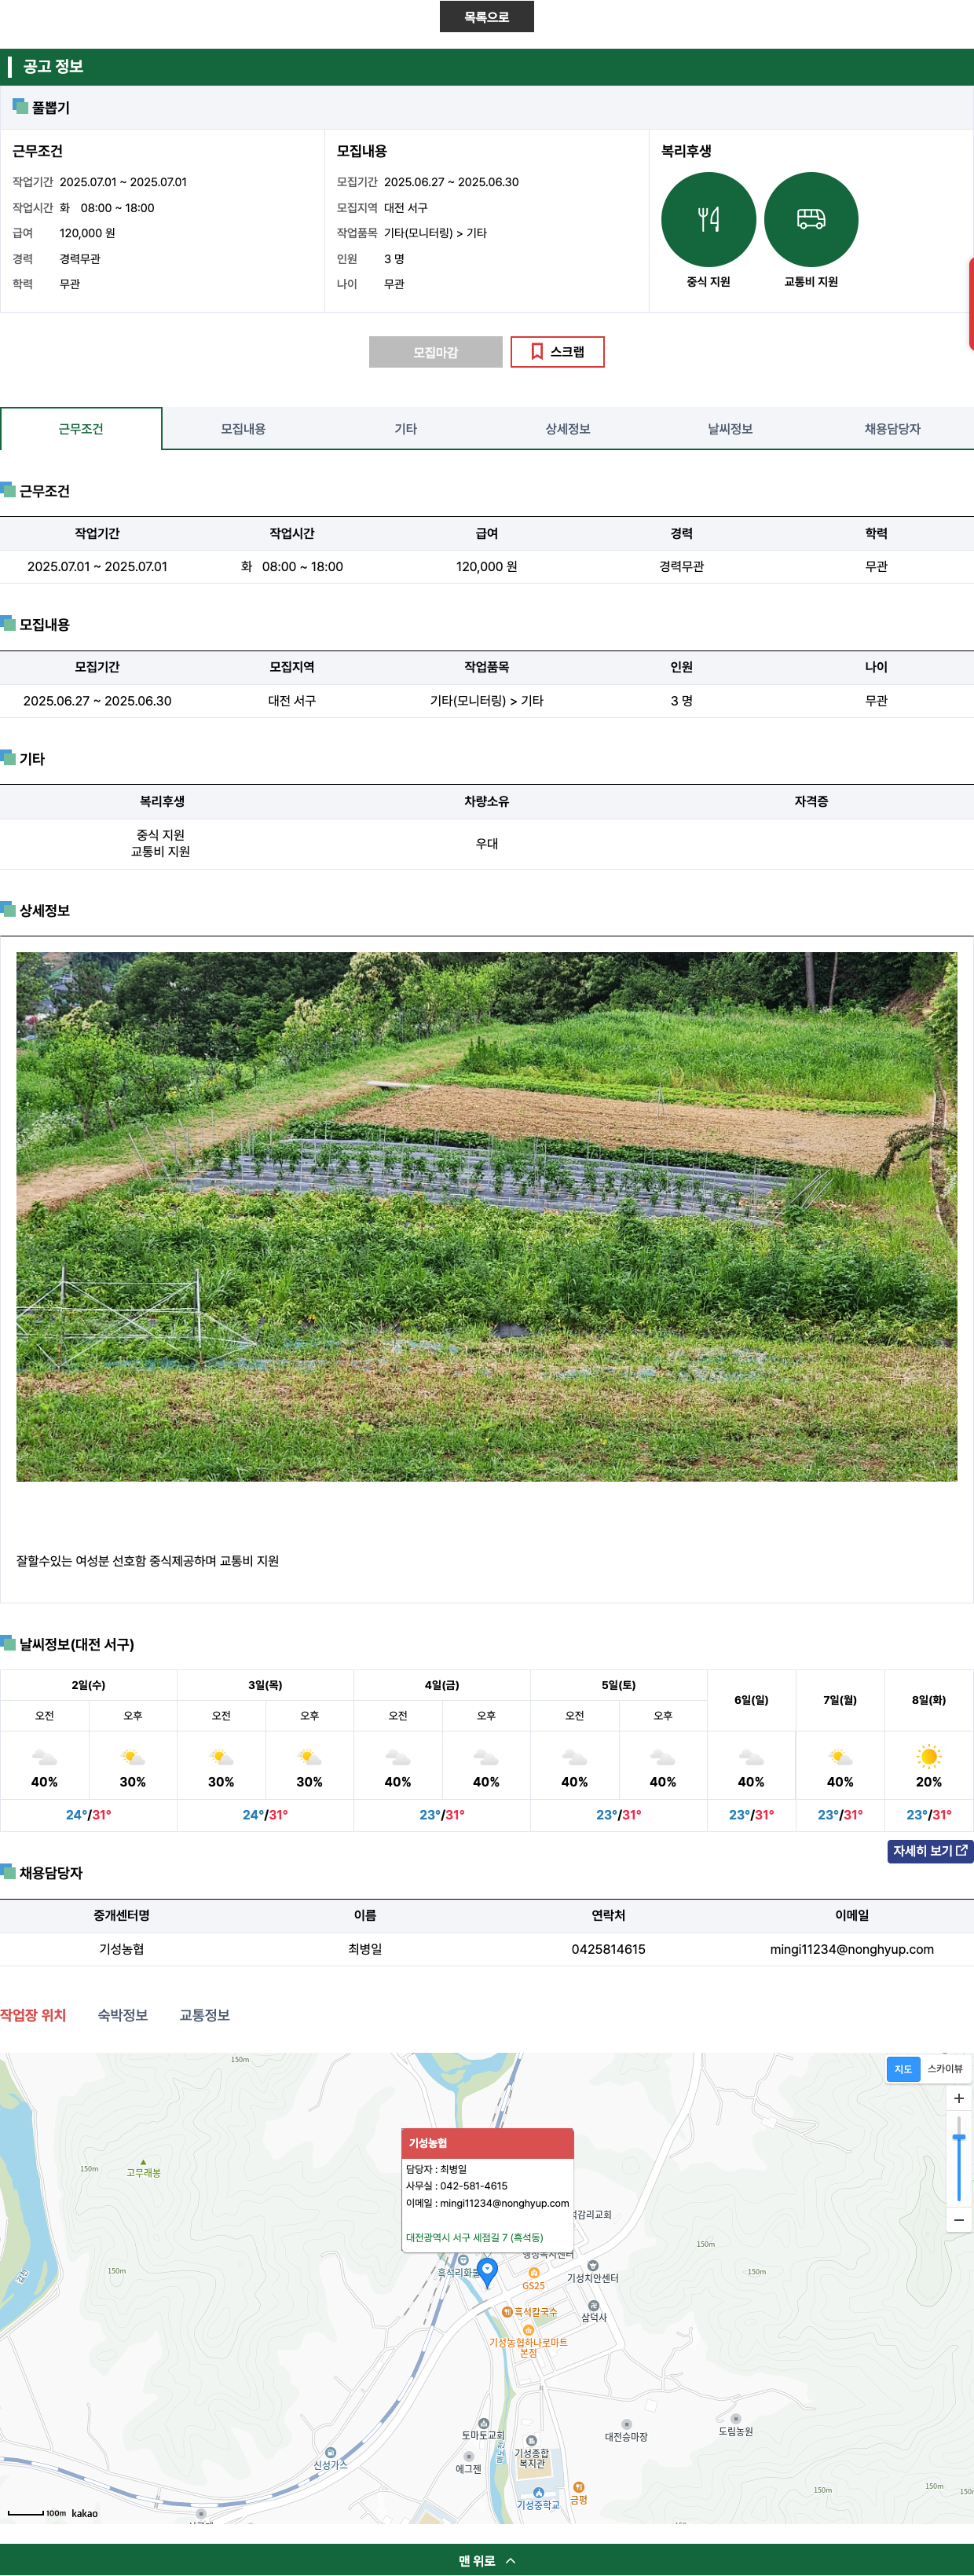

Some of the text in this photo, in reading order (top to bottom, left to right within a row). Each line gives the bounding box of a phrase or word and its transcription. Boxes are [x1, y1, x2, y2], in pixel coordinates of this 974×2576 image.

[465, 12, 509, 24] 목록으로
[24, 59, 83, 74] 공고 정보
[32, 101, 69, 115] 풀뽑기
[13, 145, 62, 158] 근무조건
[337, 145, 387, 158] 모집내용
[661, 145, 711, 158] 복리후생
[13, 177, 53, 187] 작업기간
[60, 178, 115, 186] 2025.07.01
[130, 178, 186, 186] 2025.07.01
[385, 178, 445, 186] 2025.06.27
[459, 178, 518, 186] 2025.06.30
[13, 203, 53, 213] 작업시간
[60, 203, 70, 213] 화
[81, 203, 112, 212] 08:00
[126, 203, 154, 212] 18:00
[385, 203, 427, 213] 대전 서구
[13, 228, 32, 238] 급여
[60, 228, 115, 240] 120,000 원
[385, 228, 452, 239] 기타(모니터링)
[467, 228, 487, 238] 기타
[13, 254, 32, 264] 경력
[60, 254, 101, 264] 경력무관
[385, 254, 404, 264] 3 명
[13, 279, 32, 289] 학력
[60, 279, 80, 289] 무관
[384, 279, 405, 289] 무관
[687, 277, 730, 288] 중식 지원
[785, 277, 837, 288] 교통비 지원
[414, 346, 459, 359] 모집마감
[551, 346, 584, 357] 스크랩
[59, 423, 103, 435] 근무조건
[222, 423, 265, 435] 모집내용
[395, 423, 417, 435] 기타
[546, 423, 590, 435] 상세정보
[709, 423, 752, 435] 날씨정보
[865, 423, 921, 435] 채용담당자
[20, 485, 69, 498] 근무조건
[20, 618, 70, 632] 모집내용
[75, 661, 120, 673] 모집기간
[270, 661, 313, 673] 모집지역
[465, 661, 509, 673] 작업품목
[671, 661, 692, 672] 인원
[866, 661, 887, 673] 나이
[20, 753, 45, 766] 기타
[140, 795, 184, 808] 복리후생
[465, 795, 509, 808] 차량소유
[795, 795, 829, 808] 자격증
[476, 838, 497, 850] 우대
[20, 904, 70, 918] 상세정보
[16, 1555, 278, 1567] 잘할수있는 여성분 선호함 중식제공하며 교통비 지원
[20, 1638, 134, 1652] 날씨정보(대전 서구)
[72, 1680, 105, 1691] 2일(수)
[248, 1680, 282, 1691] 3일(목)
[425, 1680, 459, 1691] 4일(금)
[602, 1680, 635, 1691] 5일(토)
[734, 1695, 768, 1706] 6일(일)
[824, 1695, 856, 1706] 7일(월)
[912, 1695, 946, 1706] 8일(화)
[35, 1711, 53, 1720] 오전
[124, 1711, 142, 1720] 오후
[212, 1711, 230, 1720] 오전
[301, 1711, 319, 1720] 오후
[31, 1776, 57, 1787] 40%
[120, 1776, 145, 1787] 30%
[208, 1776, 234, 1787] 30%
[297, 1776, 322, 1787] 30%
[385, 1776, 411, 1787] 40%
[473, 1777, 500, 1787] 40%
[562, 1776, 588, 1787] 40%
[917, 1776, 942, 1787] 20%
[67, 1809, 111, 1821] 24°/31°
[420, 1809, 464, 1821] 23°/31°
[597, 1809, 641, 1821] 23°/31°
[894, 1845, 952, 1857] 자세히 보기
[20, 1867, 82, 1880] 채용담당자
[93, 1909, 149, 1922] 중개센터명
[354, 1909, 376, 1922] 이름
[592, 1909, 624, 1922] 연락처
[836, 1909, 869, 1922] 이메일
[100, 1944, 143, 1955] 기성농협
[349, 1944, 382, 1955] 최병일
[572, 1944, 645, 1954] 0425814615
[771, 1944, 933, 1957] mingi11234@nonghyup.com
[0, 2009, 65, 2022] 작업장 위치
[98, 2009, 148, 2022] 숙박정보
[180, 2009, 229, 2022] 교통정보
[895, 2065, 912, 2074] 지도
[928, 2064, 963, 2073] 스카이뷰
[409, 2138, 446, 2149] 기성농협
[126, 2168, 161, 2178] 고무래봉
[407, 2164, 433, 2174] 담당자
[441, 2164, 466, 2174] 최병일
[406, 2181, 432, 2190] 사무실
[407, 2198, 432, 2208] 이메일
[441, 2199, 569, 2209] mingi11234@nonghyup.com
[407, 2233, 449, 2242] 대전광역시
[453, 2233, 471, 2242] 서구
[474, 2233, 499, 2242] 세점길
[511, 2233, 543, 2243] (흑석동)
[568, 2274, 618, 2283] 기성치안센터
[514, 2307, 558, 2317] 흑석칼국수
[582, 2313, 607, 2322] 삼덕사
[490, 2337, 568, 2348] 기성농협하나로마트
[520, 2348, 536, 2358] 본점
[462, 2431, 504, 2441] 토마토교회
[606, 2432, 648, 2442] 대전승마장
[719, 2427, 752, 2436] 도림농원
[515, 2449, 549, 2458] 기성종합
[314, 2460, 348, 2472] 신성가스
[456, 2464, 481, 2474] 에그젠
[519, 2459, 545, 2468] 복지관
[518, 2501, 560, 2510] 기성중학교
[570, 2495, 587, 2505] 금평
[460, 2555, 496, 2567] 맨 위로
